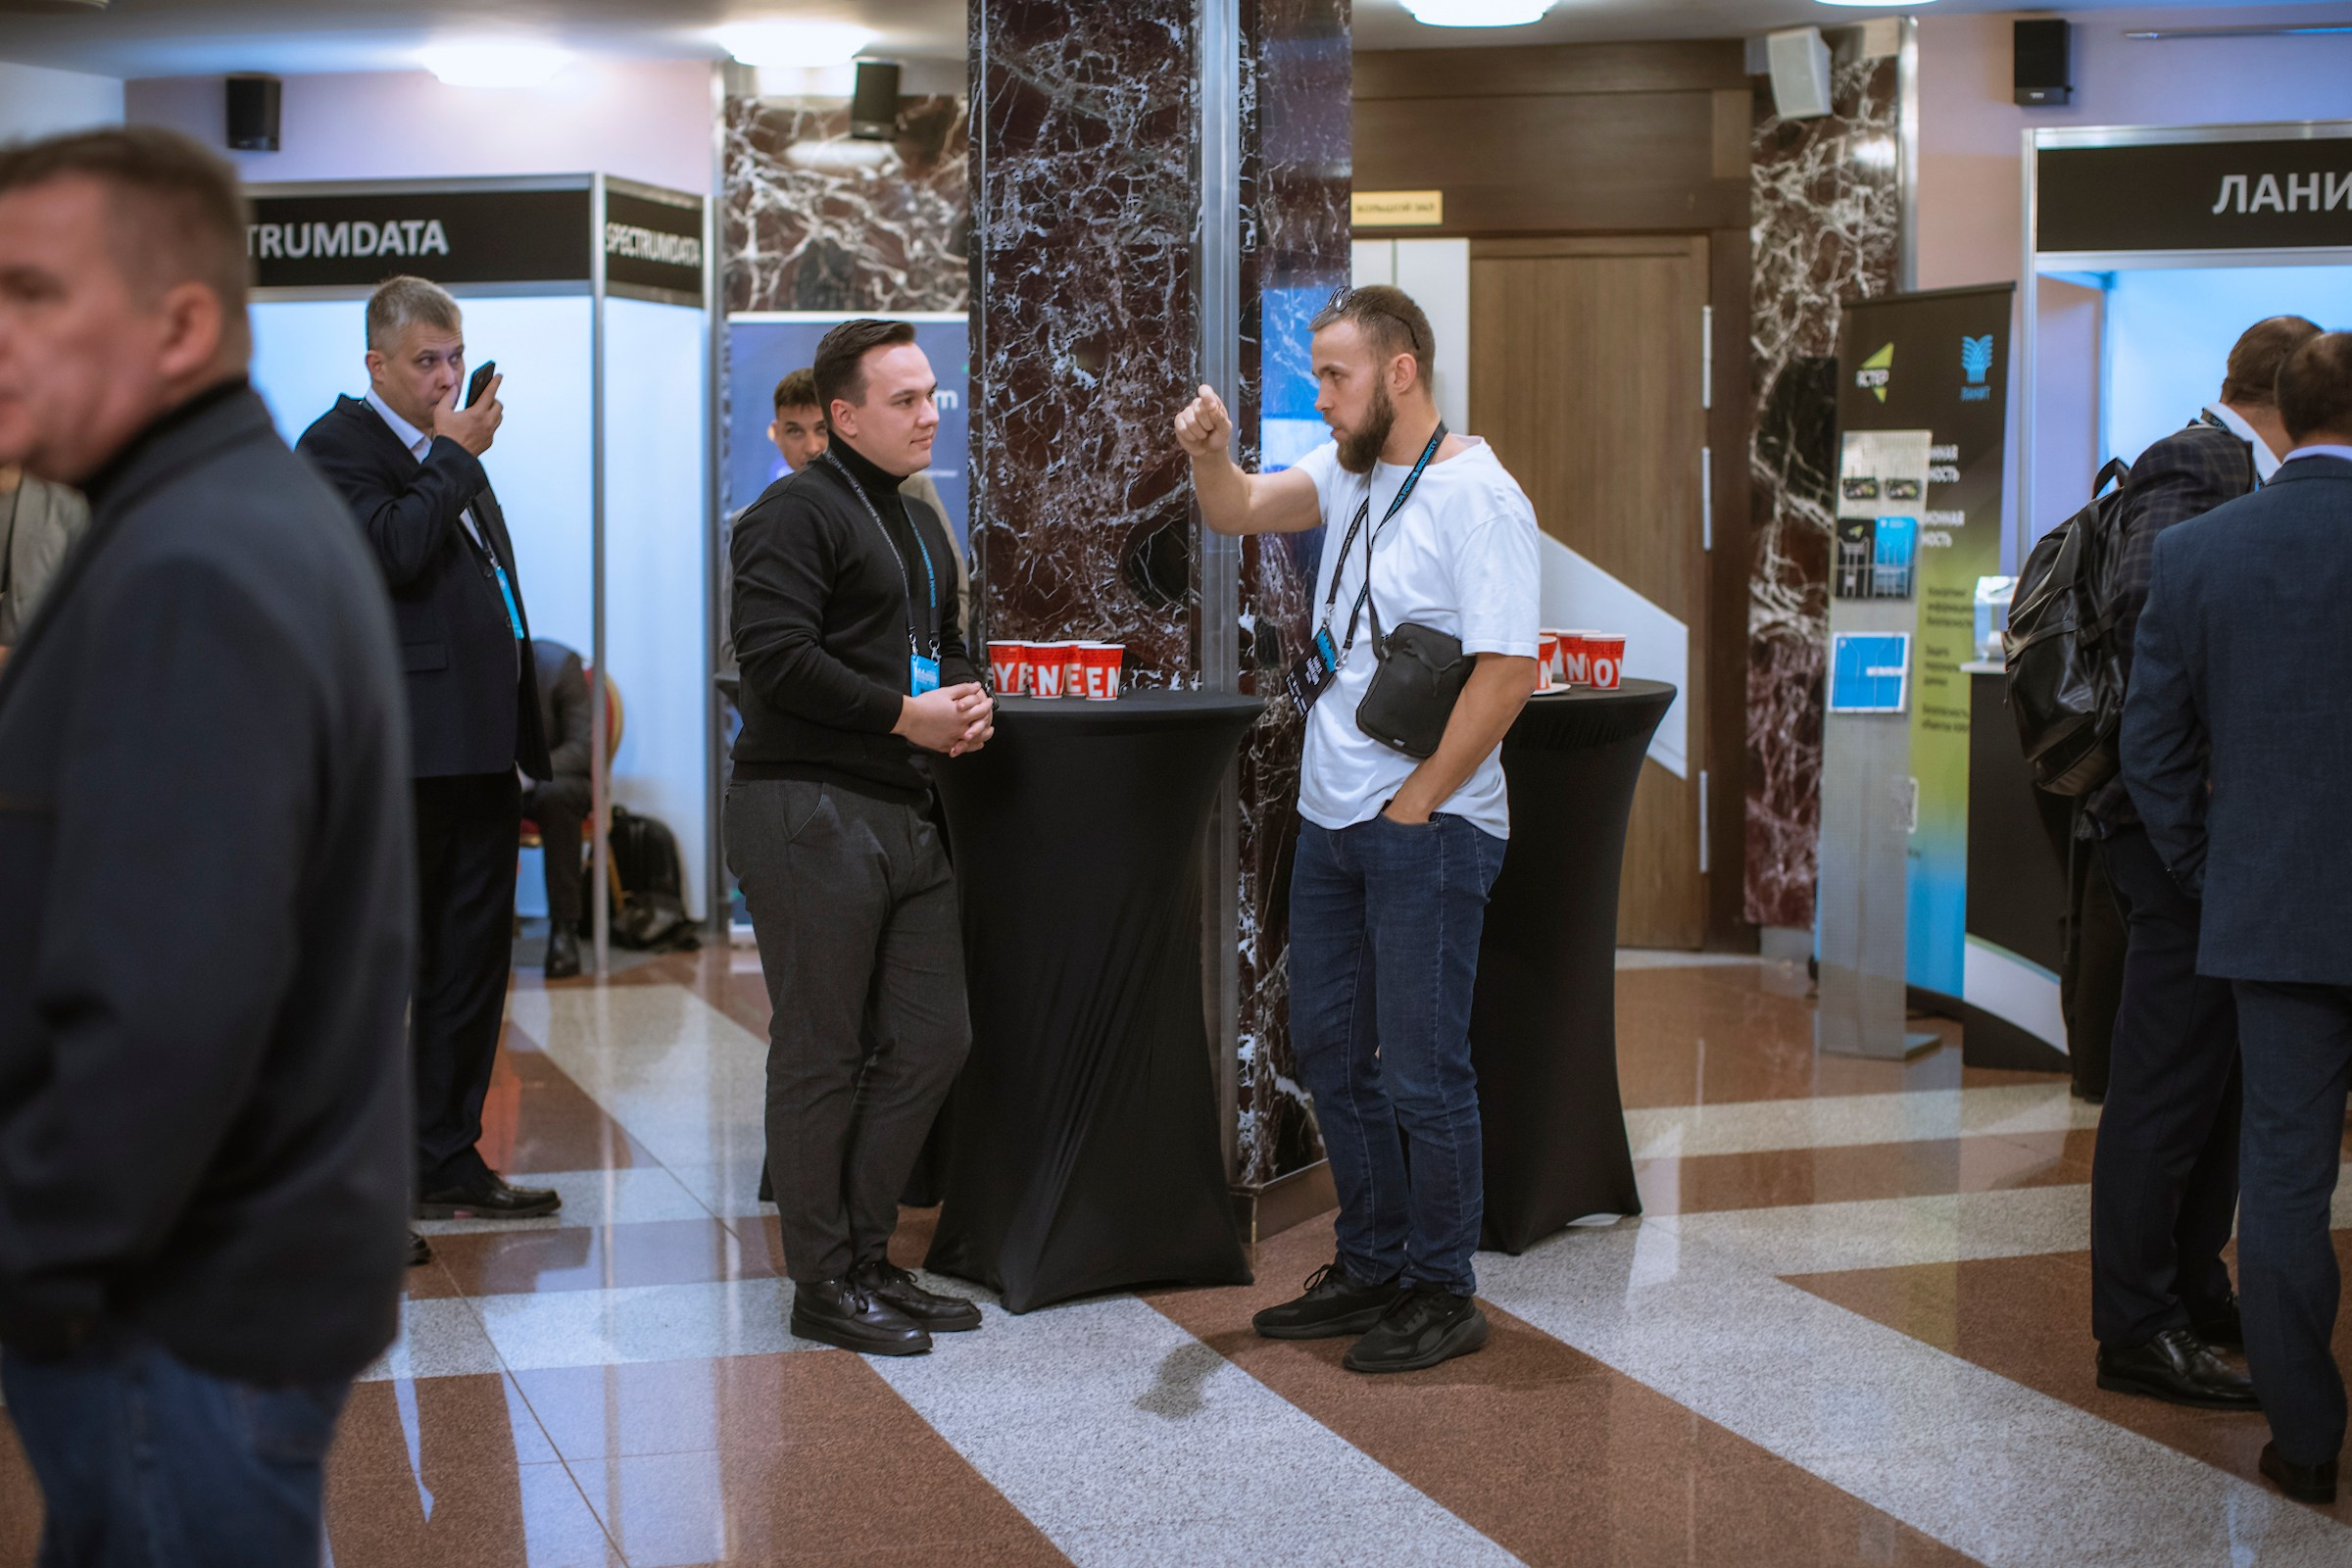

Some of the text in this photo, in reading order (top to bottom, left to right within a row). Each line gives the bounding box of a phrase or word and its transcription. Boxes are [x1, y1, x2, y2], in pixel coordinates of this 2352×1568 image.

[2212, 171, 2352, 215] ЛАНИ
[247, 220, 450, 259] TRUMDATA
[1028, 664, 1064, 695] EN
